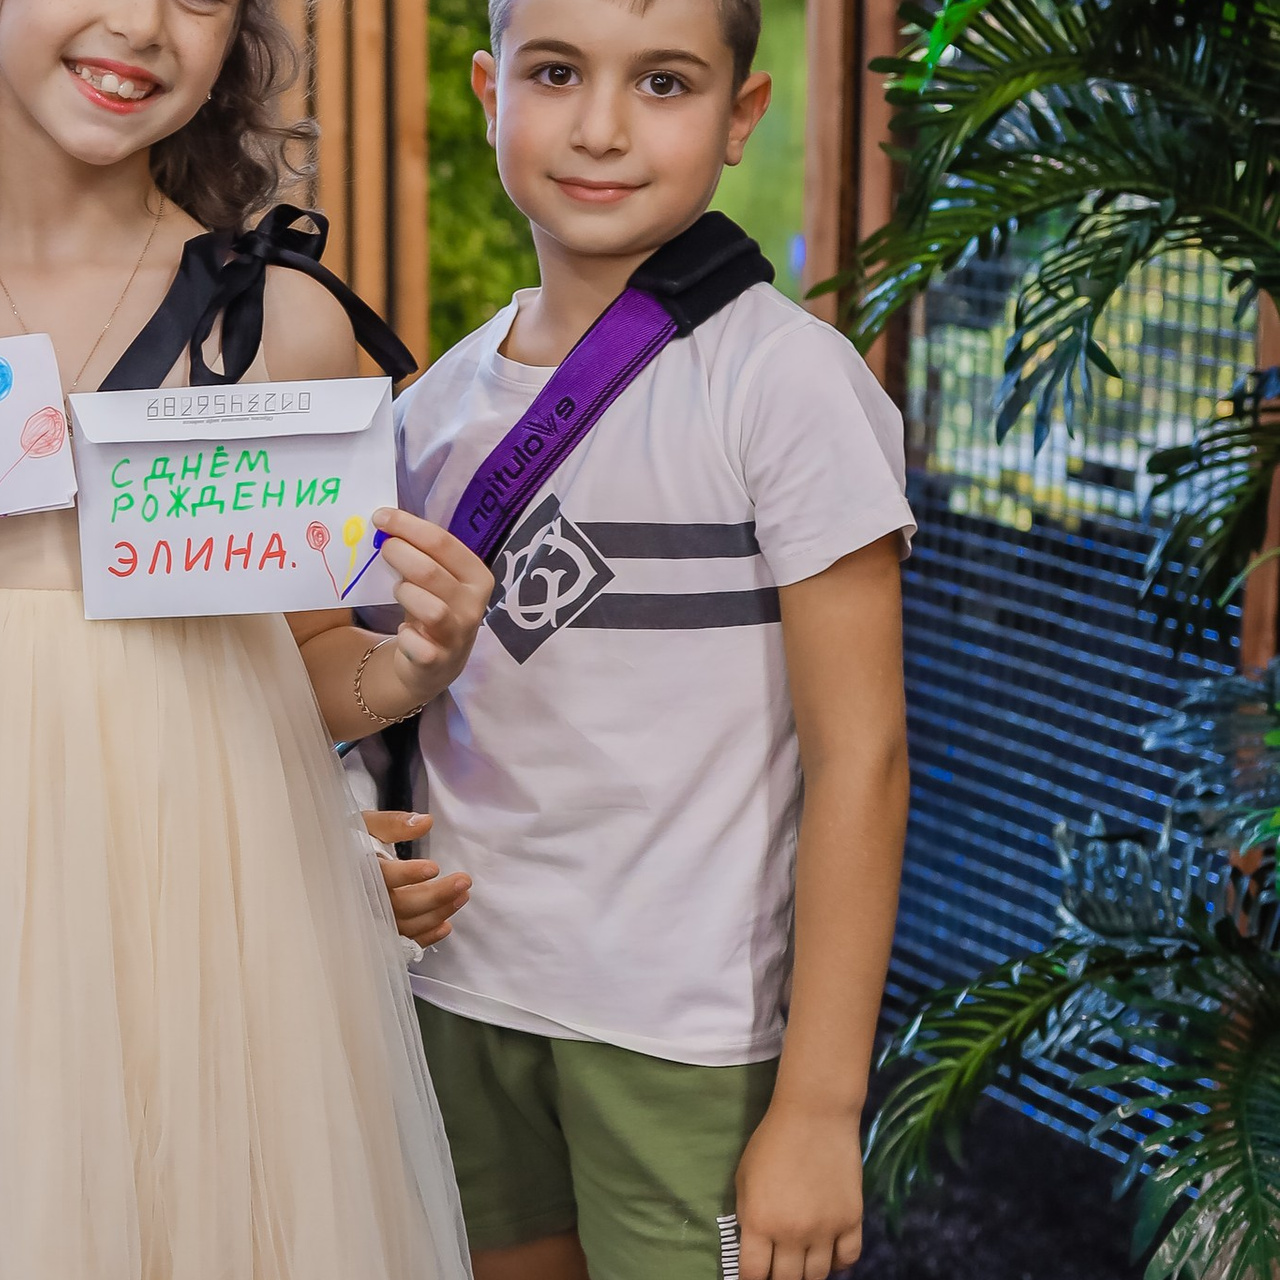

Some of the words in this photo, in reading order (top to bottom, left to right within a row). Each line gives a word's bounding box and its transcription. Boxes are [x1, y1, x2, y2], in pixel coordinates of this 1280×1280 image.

[110, 457, 132, 490] С
[142, 444, 271, 492] ДНЁМ
[110, 477, 341, 524] РОЖДЕНИЯ
[108, 531, 297, 578] ЭЛИНА.
